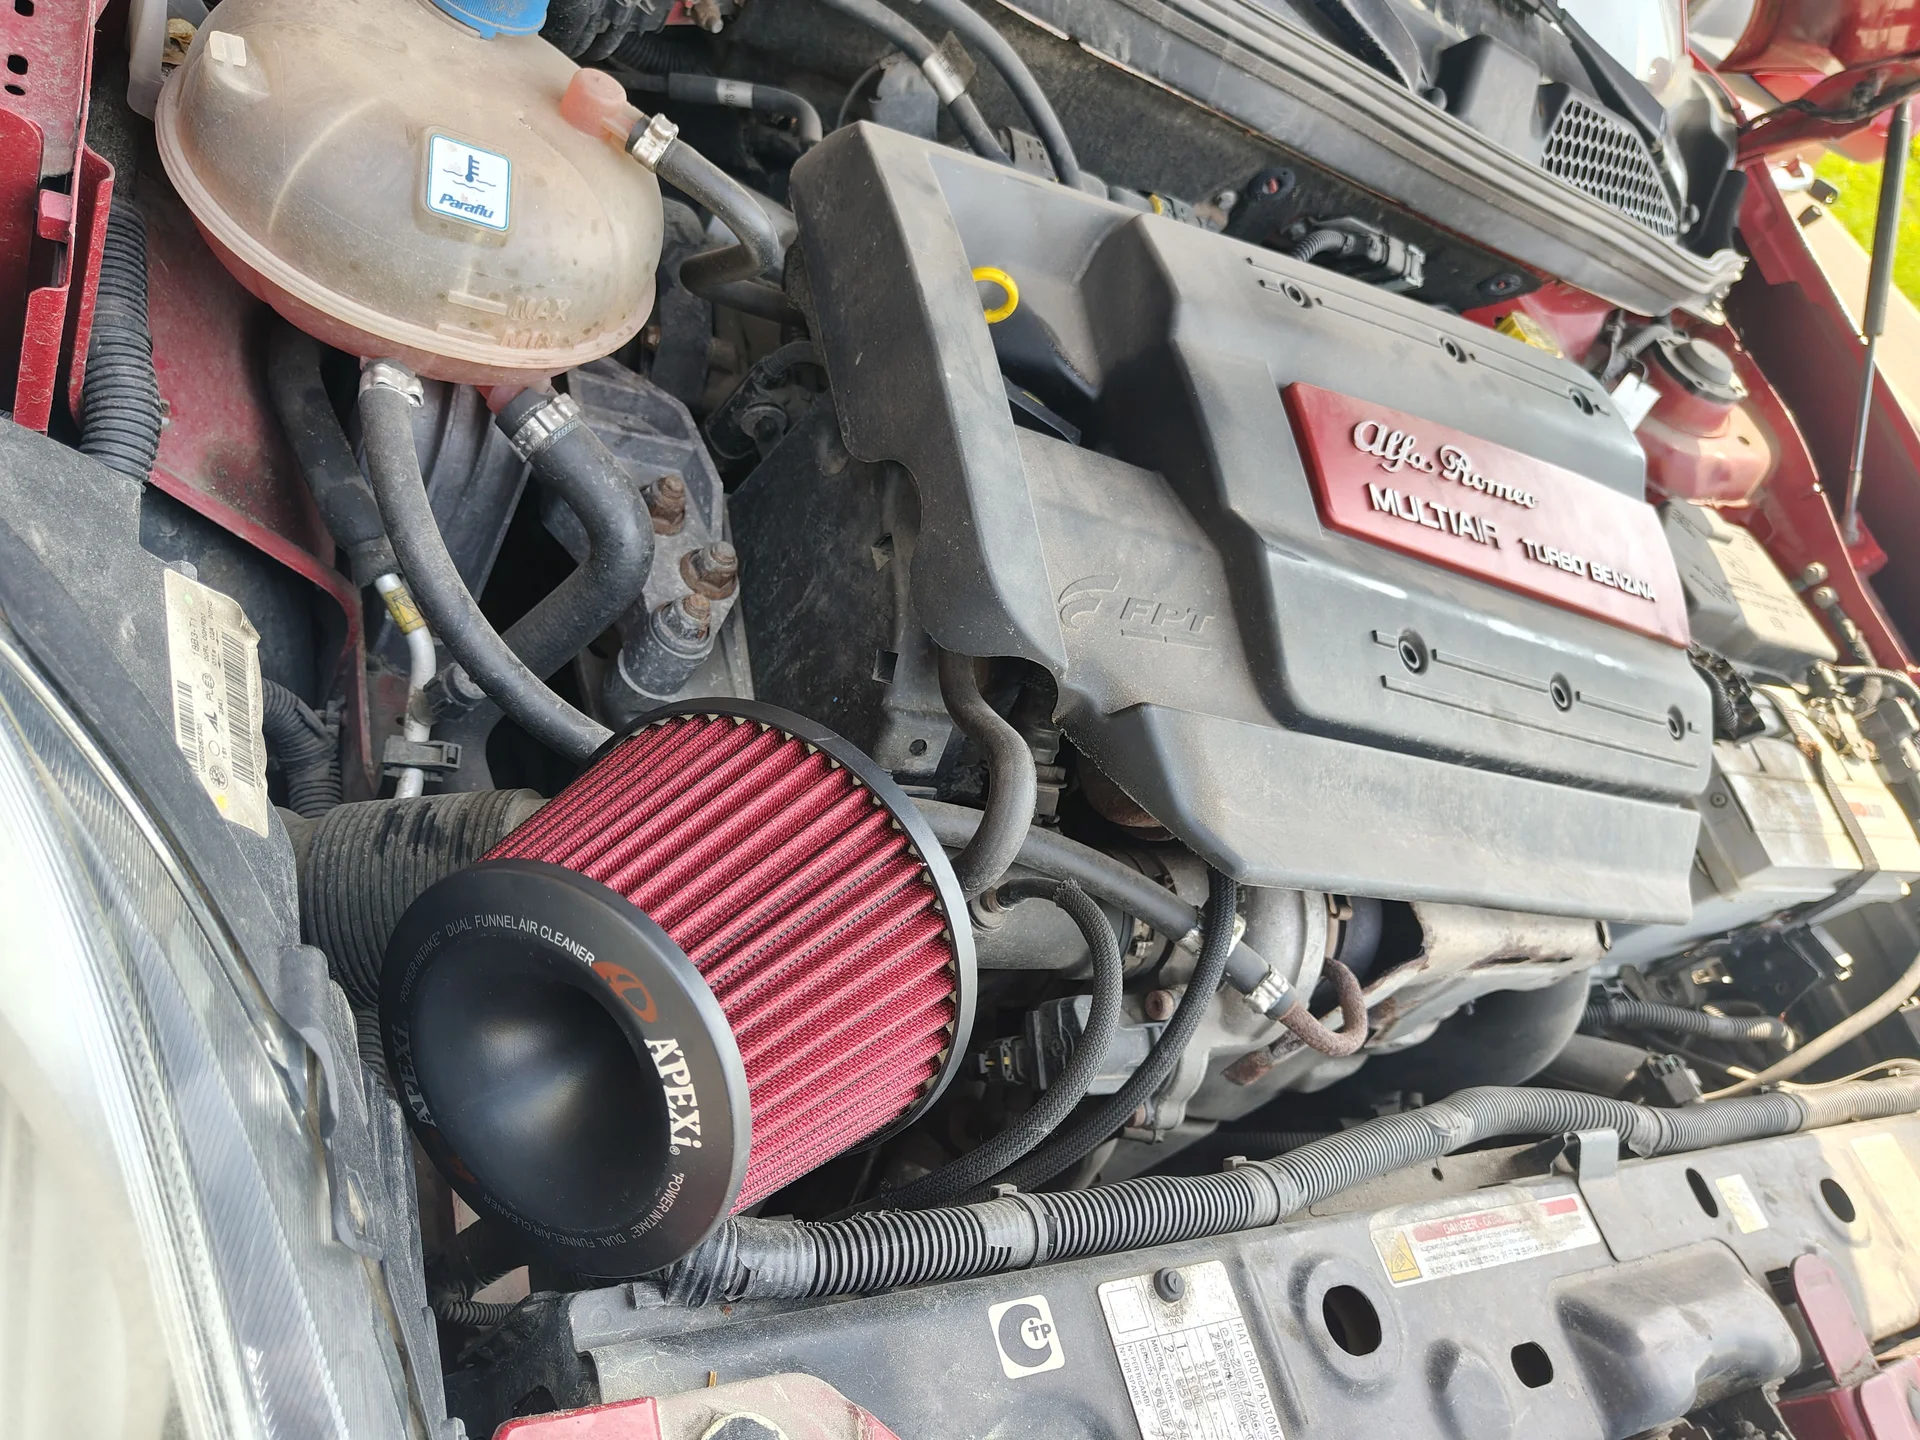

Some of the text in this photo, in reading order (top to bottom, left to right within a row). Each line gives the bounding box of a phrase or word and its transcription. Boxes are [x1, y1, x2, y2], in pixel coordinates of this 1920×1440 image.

[439, 193, 494, 218] Paraflu
[508, 296, 571, 321] MAX
[1352, 419, 1539, 509] Alfa Romeo
[1367, 482, 1503, 550] MULTIAIR
[1520, 537, 1586, 578] TURBO
[1590, 560, 1658, 602] BENZINA
[1119, 597, 1217, 633] FPT
[445, 918, 473, 937] DUAL
[474, 914, 518, 930] FUNNEL
[518, 918, 539, 935] AIR
[539, 925, 596, 967] CLEANER
[483, 1193, 532, 1231] CLEANER
[533, 1225, 551, 1240] AIR
[550, 1232, 596, 1249] FUNNEL
[596, 1232, 627, 1248] DUAL
[1234, 1322, 1249, 1347] FIAT
[1243, 1350, 1265, 1390] GROUP
